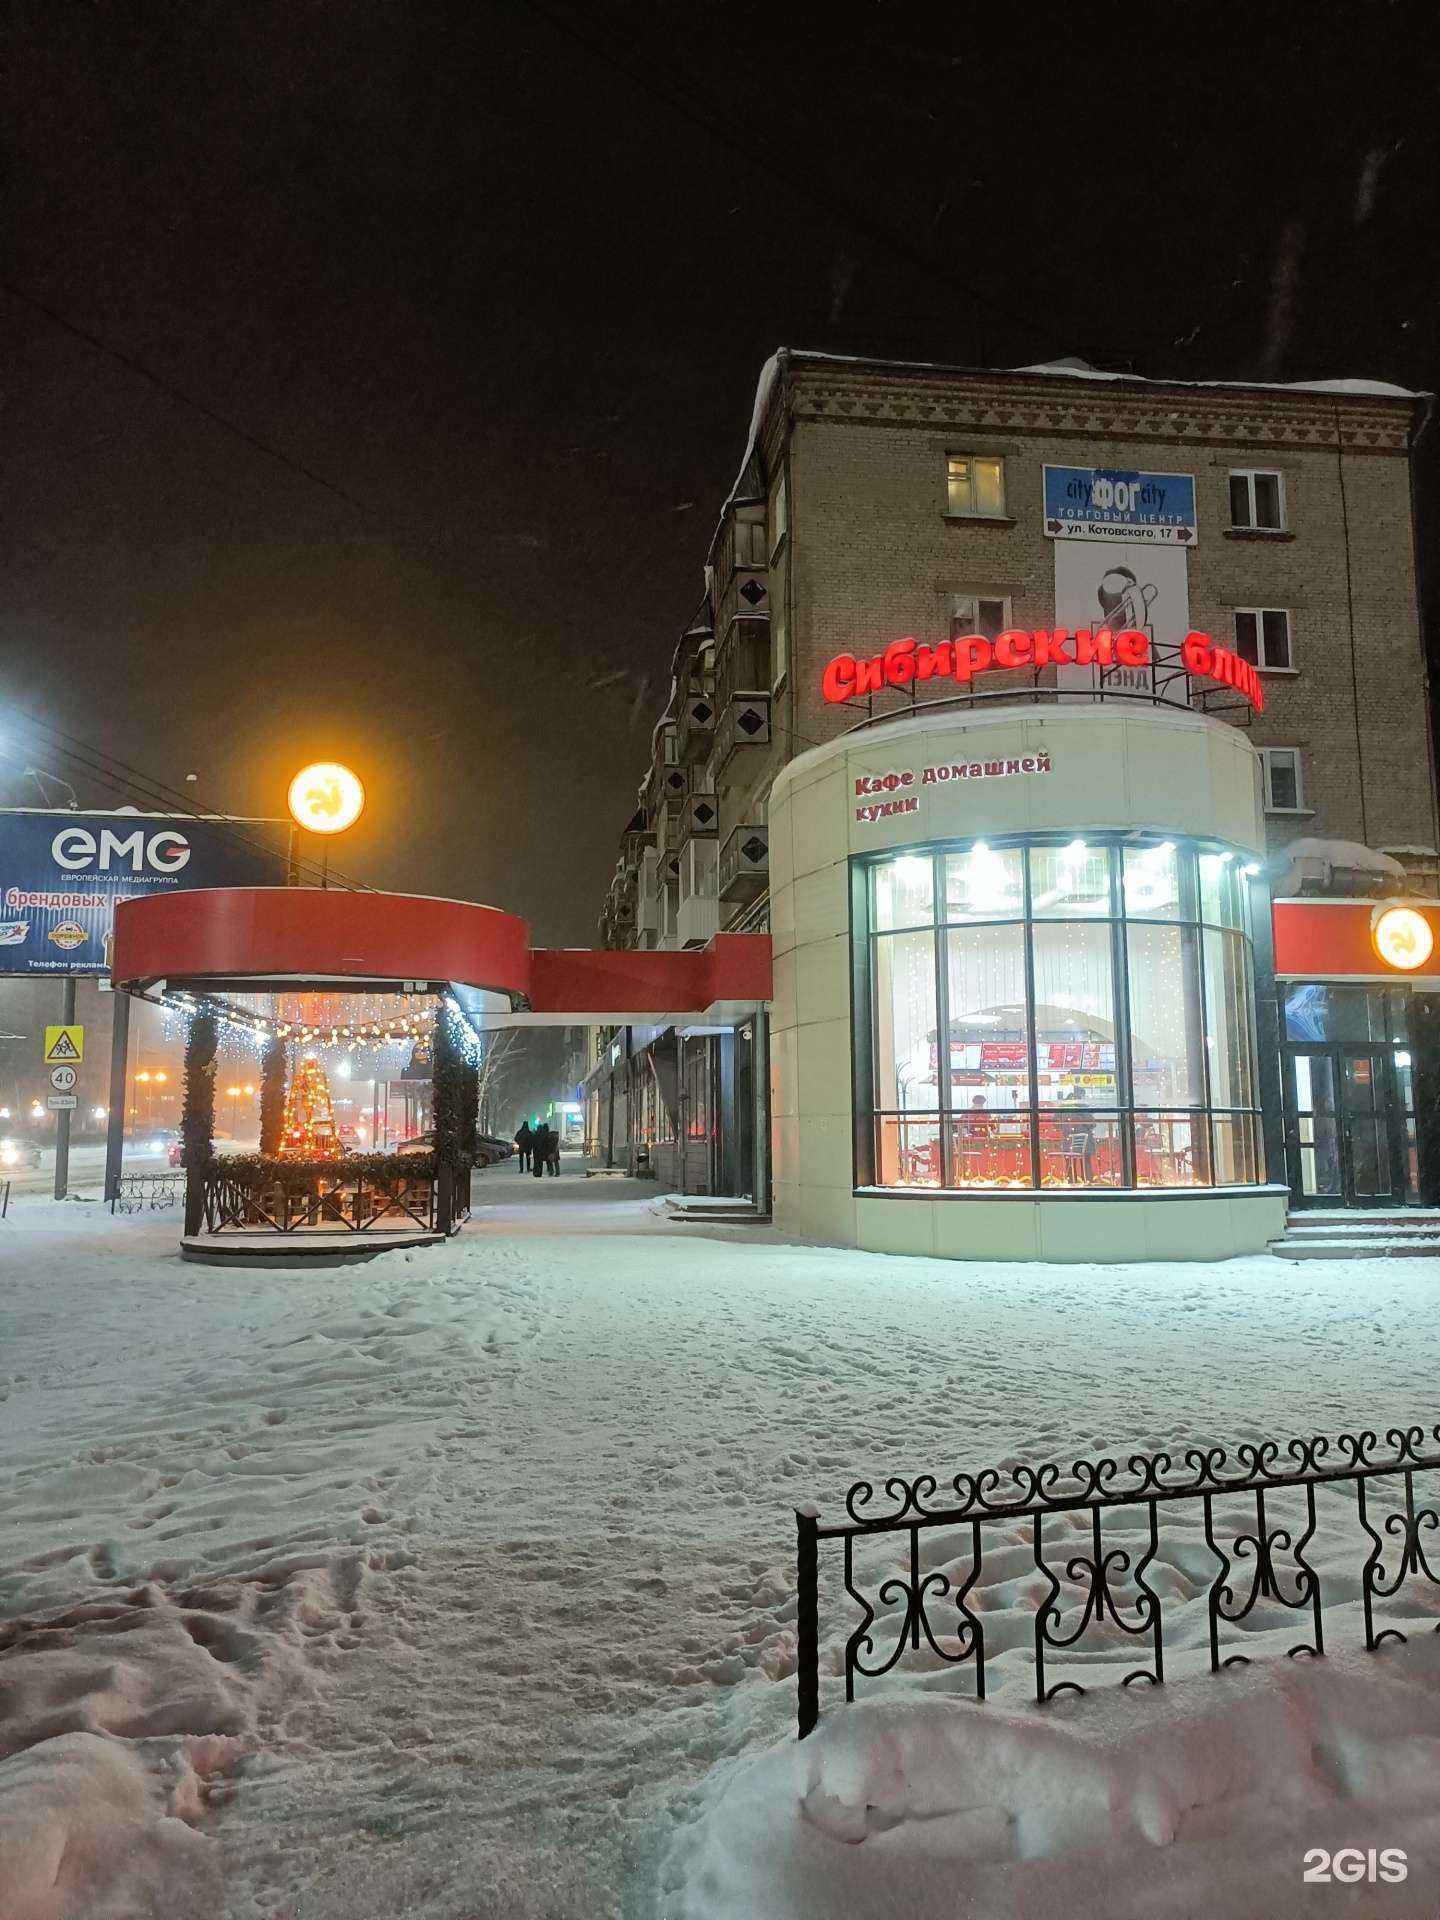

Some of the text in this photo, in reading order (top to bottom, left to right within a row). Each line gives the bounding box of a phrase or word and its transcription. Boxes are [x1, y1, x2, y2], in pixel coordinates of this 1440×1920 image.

[1058, 507, 1184, 526] ТОРГОВЫЙ ЦЕНТР
[1067, 523, 1086, 535] ул.
[1160, 527, 1172, 539] 17
[822, 628, 1150, 703] Сибирские
[855, 752, 1051, 797] Кафе домашней
[856, 797, 919, 822] кухни
[61, 873, 179, 885] ЕВРОПЕЙСКАЯ МЕДИАГРУППА
[7, 887, 105, 909] брендовых
[28, 959, 69, 969] Телефон
[55, 1072, 74, 1084] 40
